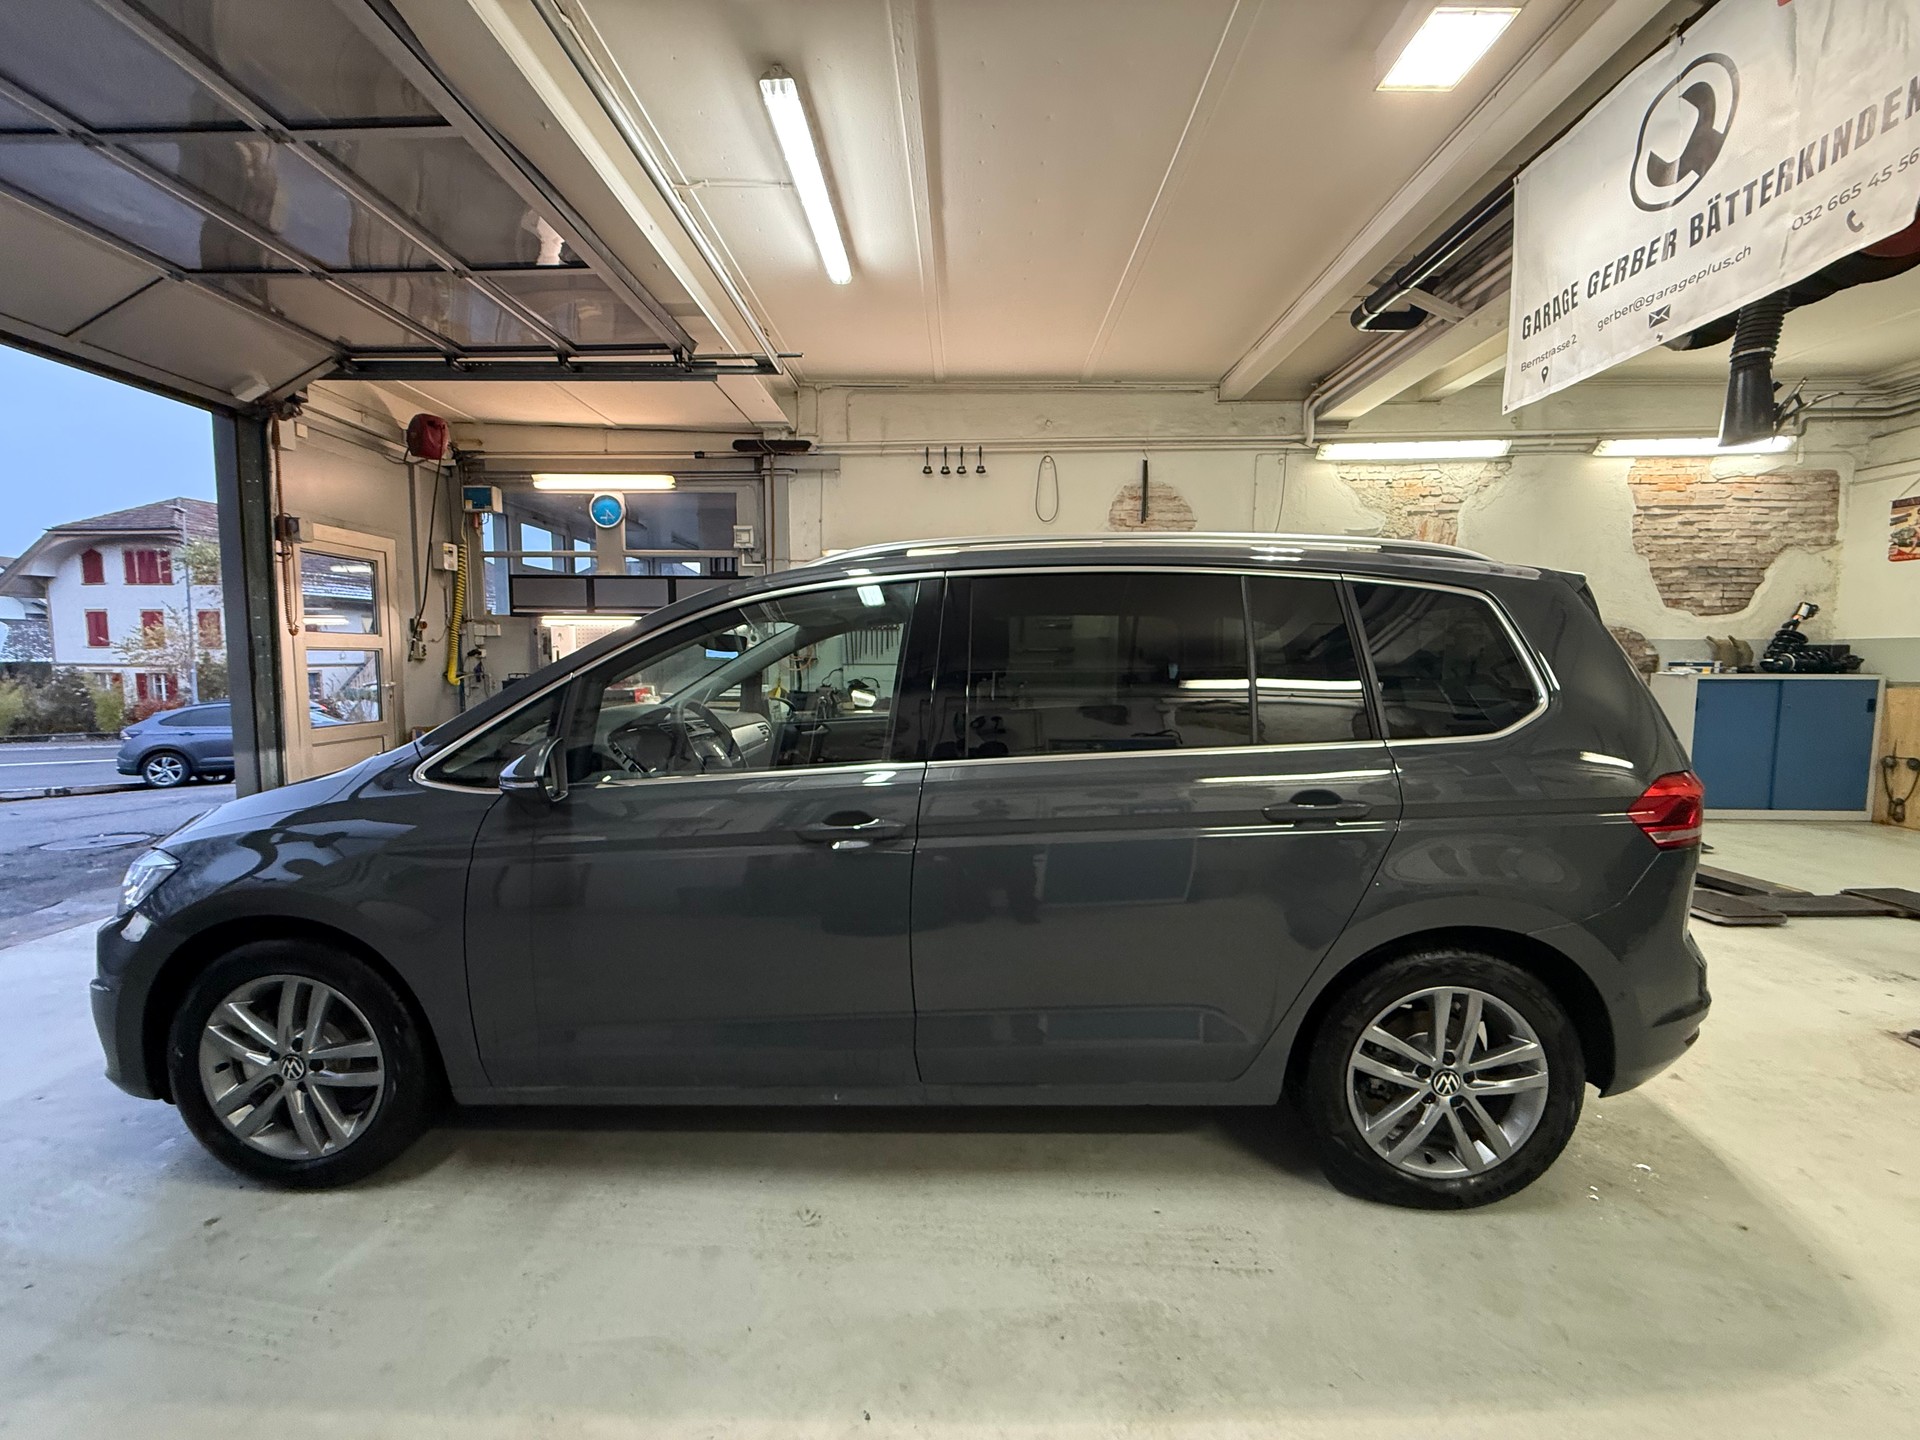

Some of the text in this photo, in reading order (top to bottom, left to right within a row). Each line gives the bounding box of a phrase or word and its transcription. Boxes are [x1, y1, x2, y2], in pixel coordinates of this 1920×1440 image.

[1522, 75, 1920, 340] GARAGE GERBER BÄTTERKINDEN
[1791, 146, 1920, 231] 032 665 45 56
[1597, 245, 1752, 332] gerber@garageplus.ch
[1520, 333, 1578, 372] Bernstrasse 2
